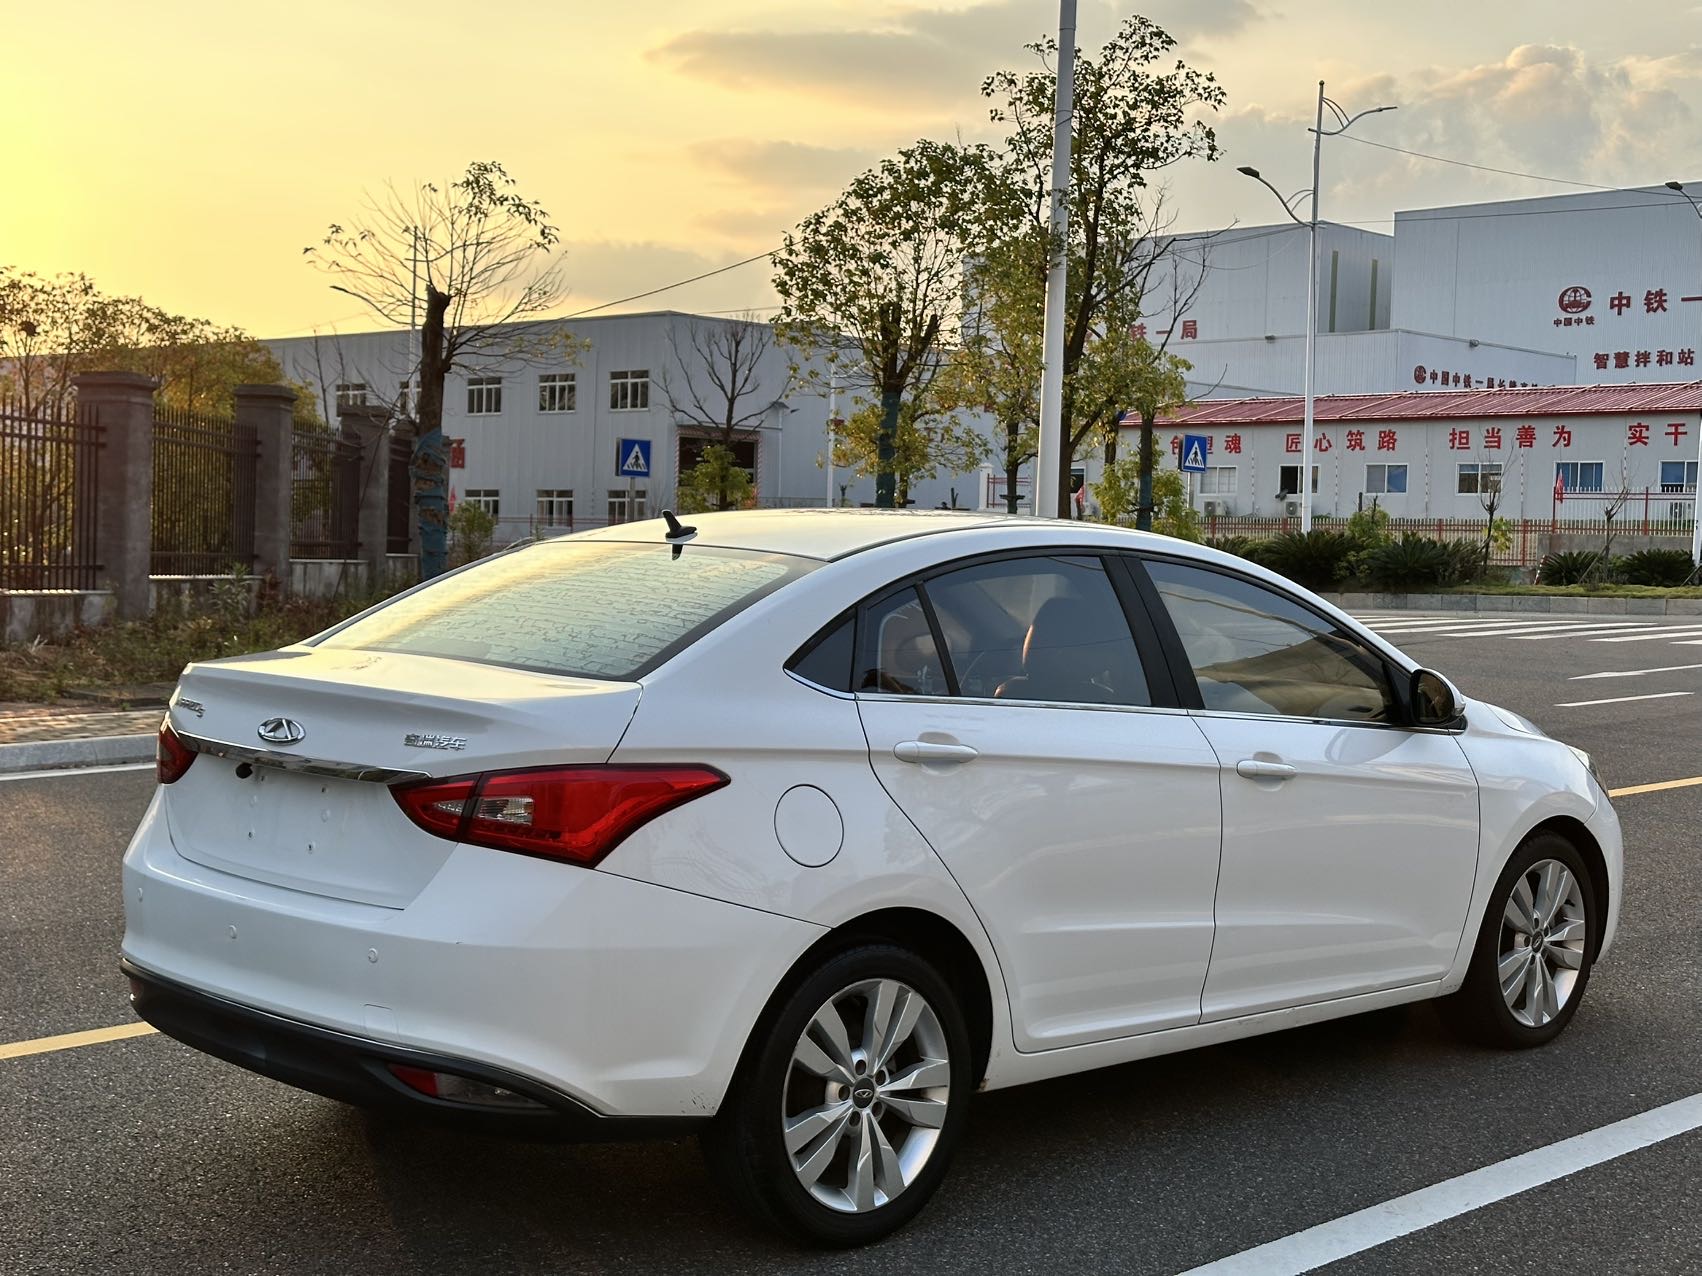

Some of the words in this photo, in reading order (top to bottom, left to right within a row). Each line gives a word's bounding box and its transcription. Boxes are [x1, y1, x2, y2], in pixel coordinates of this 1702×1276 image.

[1553, 315, 1596, 328] 中国中铁
[1593, 348, 1695, 370] 智慧拌和站
[1285, 429, 1398, 453] 匠心筑路
[1449, 424, 1572, 450] 担当善为
[1627, 422, 1688, 447] 实干
